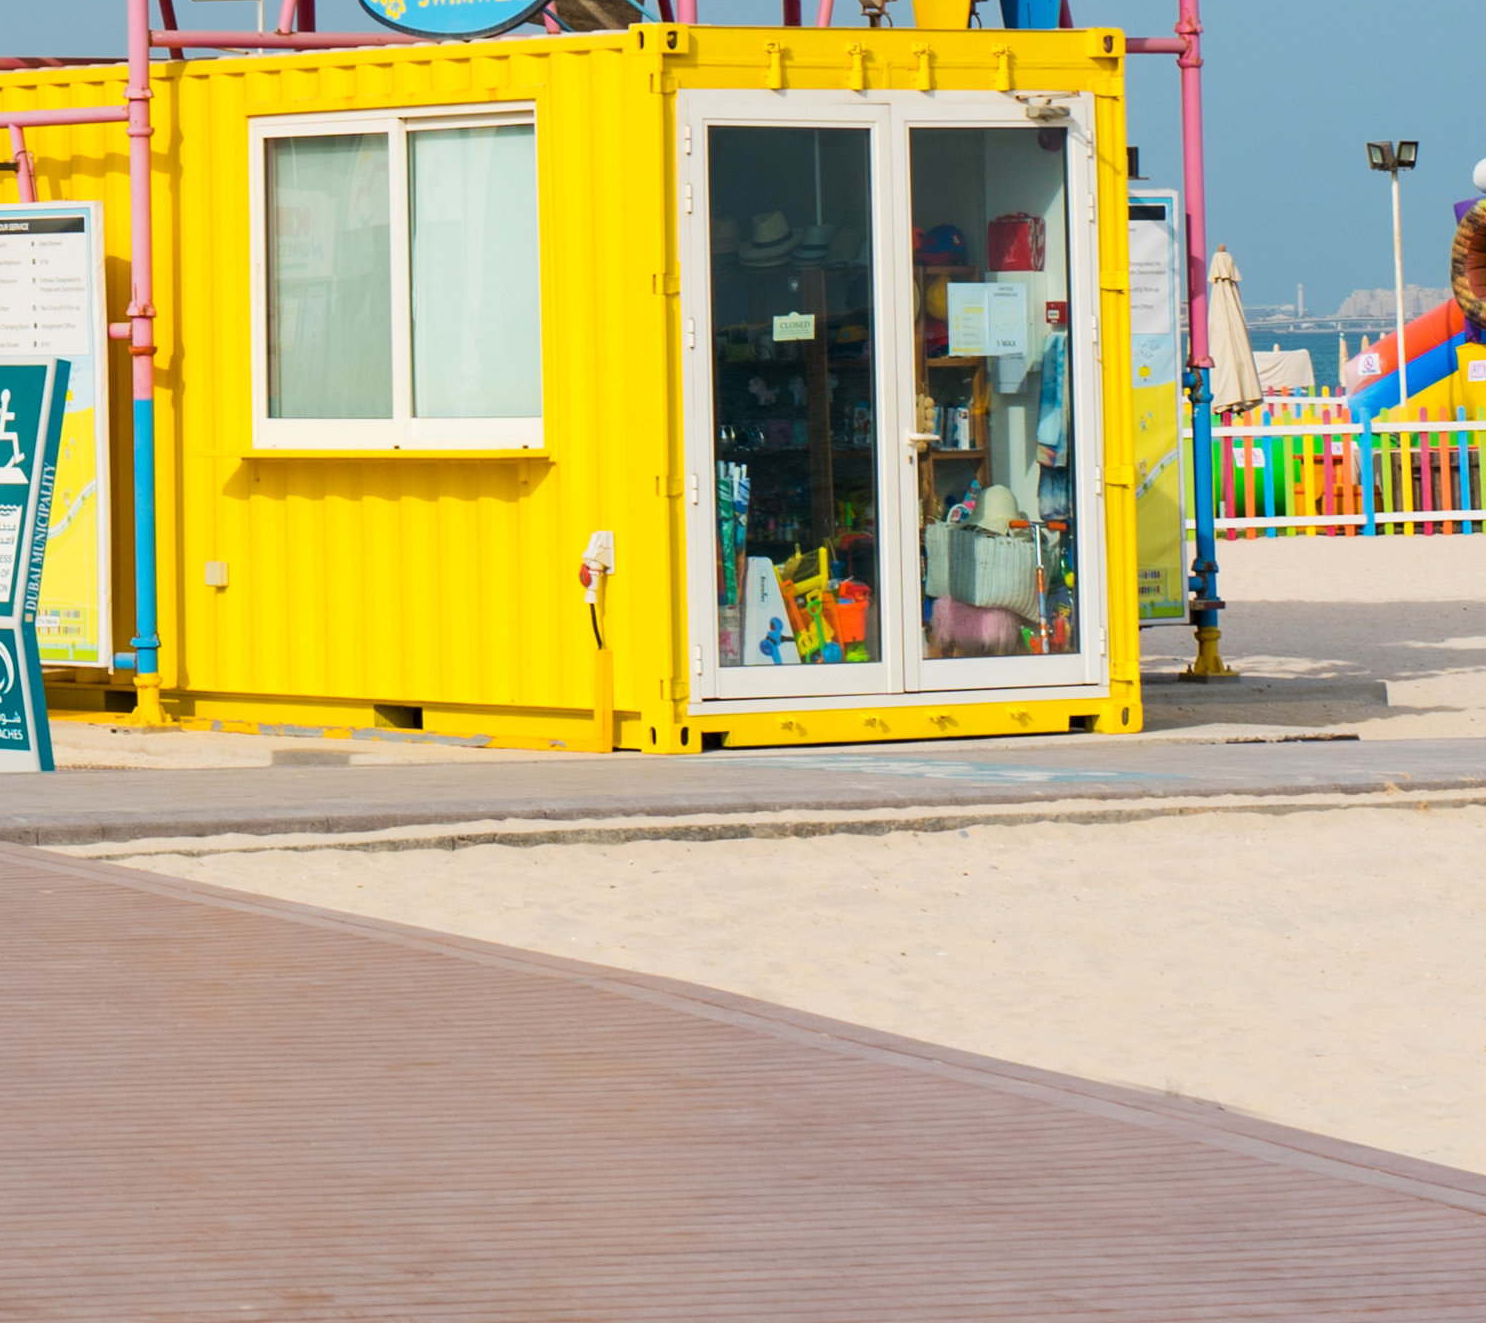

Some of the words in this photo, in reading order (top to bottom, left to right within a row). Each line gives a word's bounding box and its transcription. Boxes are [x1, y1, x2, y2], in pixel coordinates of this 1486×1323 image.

[779, 320, 811, 330] CLOSED
[31, 462, 56, 565] MUNICIPALITY
[1, 568, 10, 578] OF
[25, 567, 40, 611] DUBAI
